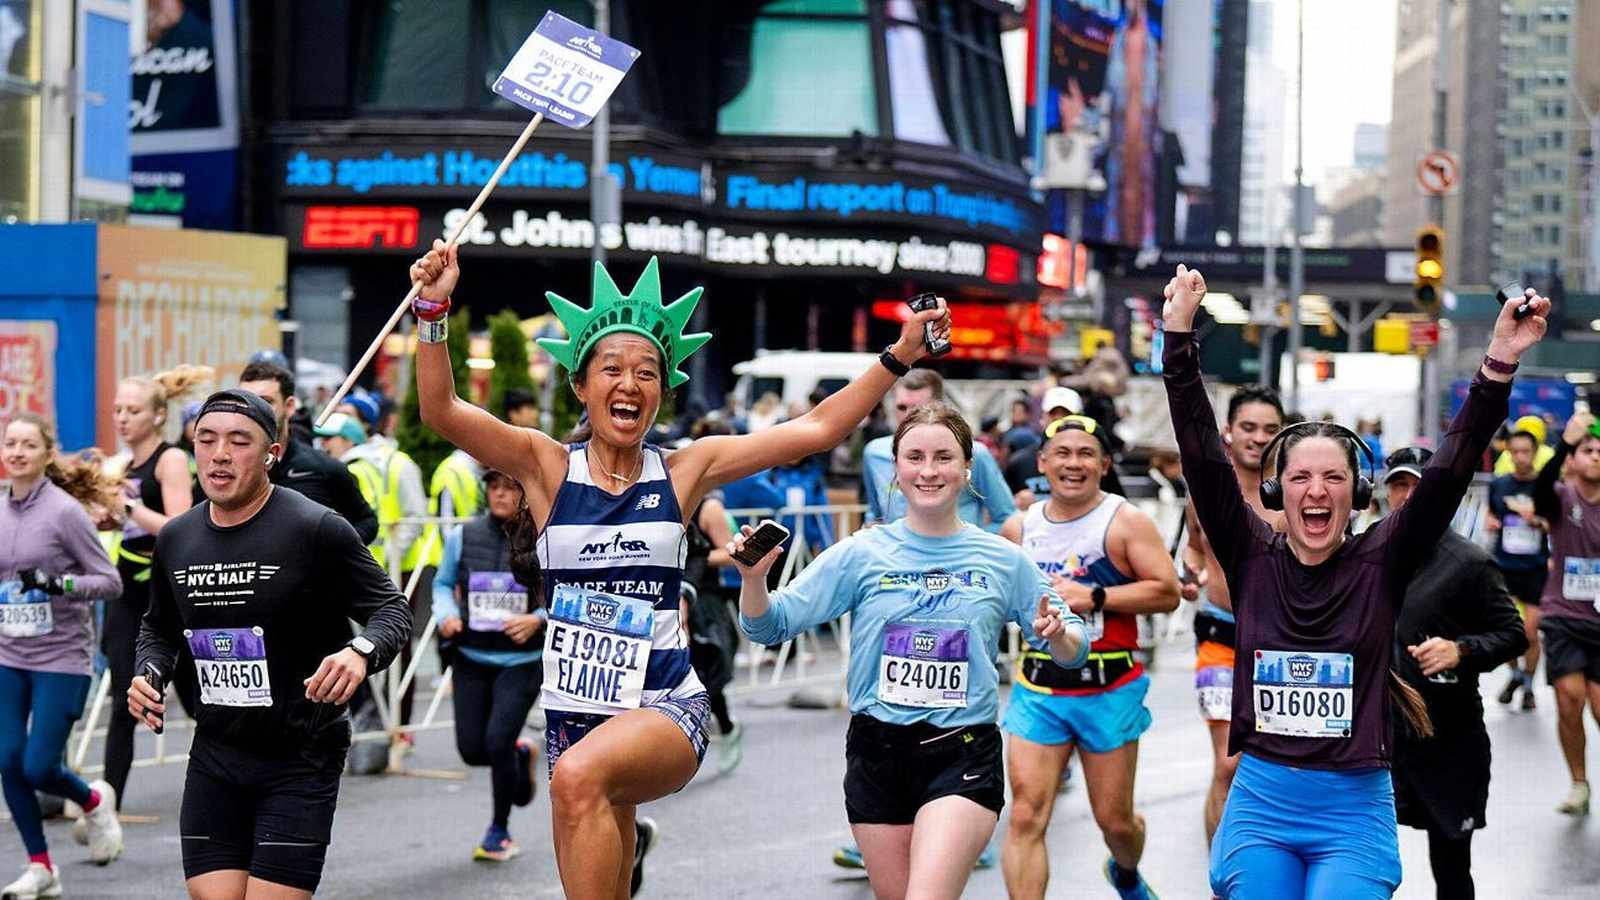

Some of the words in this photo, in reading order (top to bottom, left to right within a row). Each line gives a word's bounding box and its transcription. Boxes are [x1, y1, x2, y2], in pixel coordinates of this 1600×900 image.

[539, 50, 570, 71] PACE
[570, 63, 605, 84] TEAM
[524, 61, 595, 105] 2:10
[336, 151, 437, 193] against
[443, 150, 586, 189] Houthis
[726, 175, 806, 212] Final
[807, 178, 902, 216] report
[303, 206, 419, 248] ESPN
[443, 208, 496, 246] St.
[499, 210, 623, 249] Johns
[706, 227, 770, 266] East
[773, 233, 898, 275] tourney
[898, 235, 947, 273] since
[187, 573, 215, 587] NYC
[218, 570, 256, 586] HALF
[223, 561, 257, 570] AIRLINES
[611, 580, 665, 596] TEAM
[588, 603, 614, 614] NYC
[214, 638, 232, 647] NYC
[915, 636, 934, 646] NYC
[201, 663, 264, 689] A24650
[557, 656, 627, 703] ELAINE
[886, 660, 961, 690] C24016
[1292, 662, 1313, 671] NYC
[1259, 689, 1346, 718] D16080
